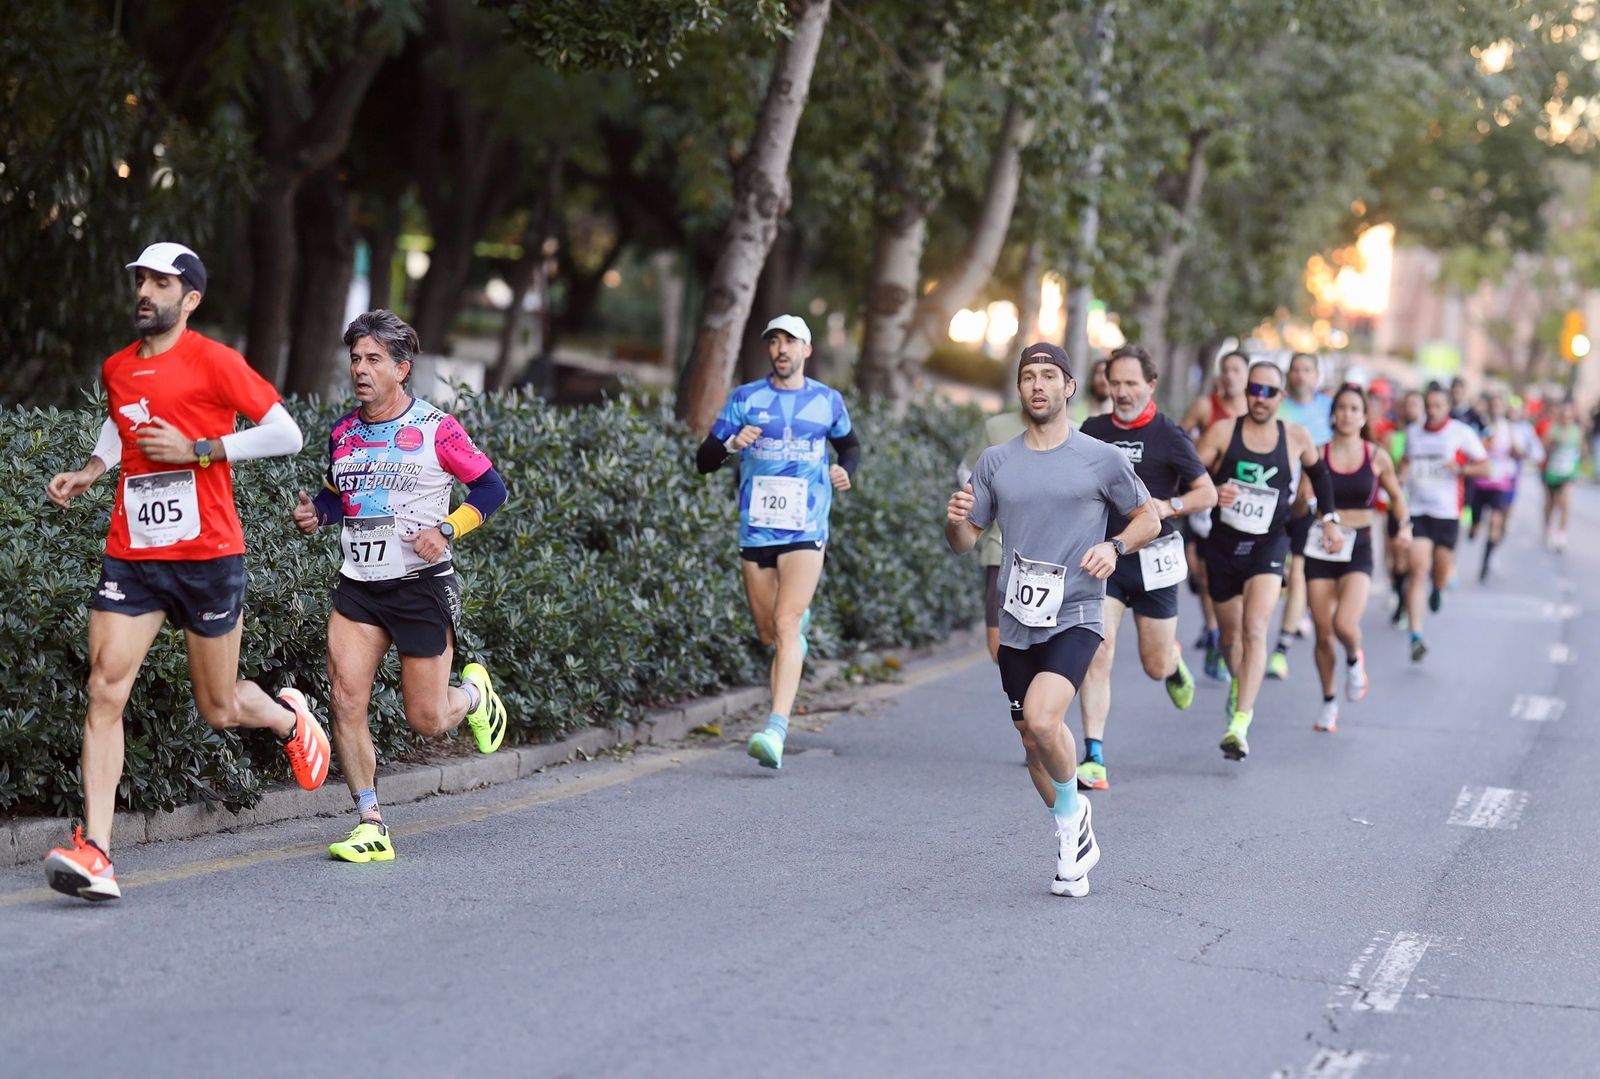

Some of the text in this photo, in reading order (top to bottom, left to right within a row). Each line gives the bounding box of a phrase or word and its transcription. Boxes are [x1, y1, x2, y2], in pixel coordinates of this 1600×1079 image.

[368, 461, 423, 475] MARATÓN
[338, 475, 418, 492] ESTEPONA
[761, 495, 787, 510] 120
[1232, 501, 1264, 520] 404
[138, 499, 183, 526] 405
[350, 540, 386, 562] 577
